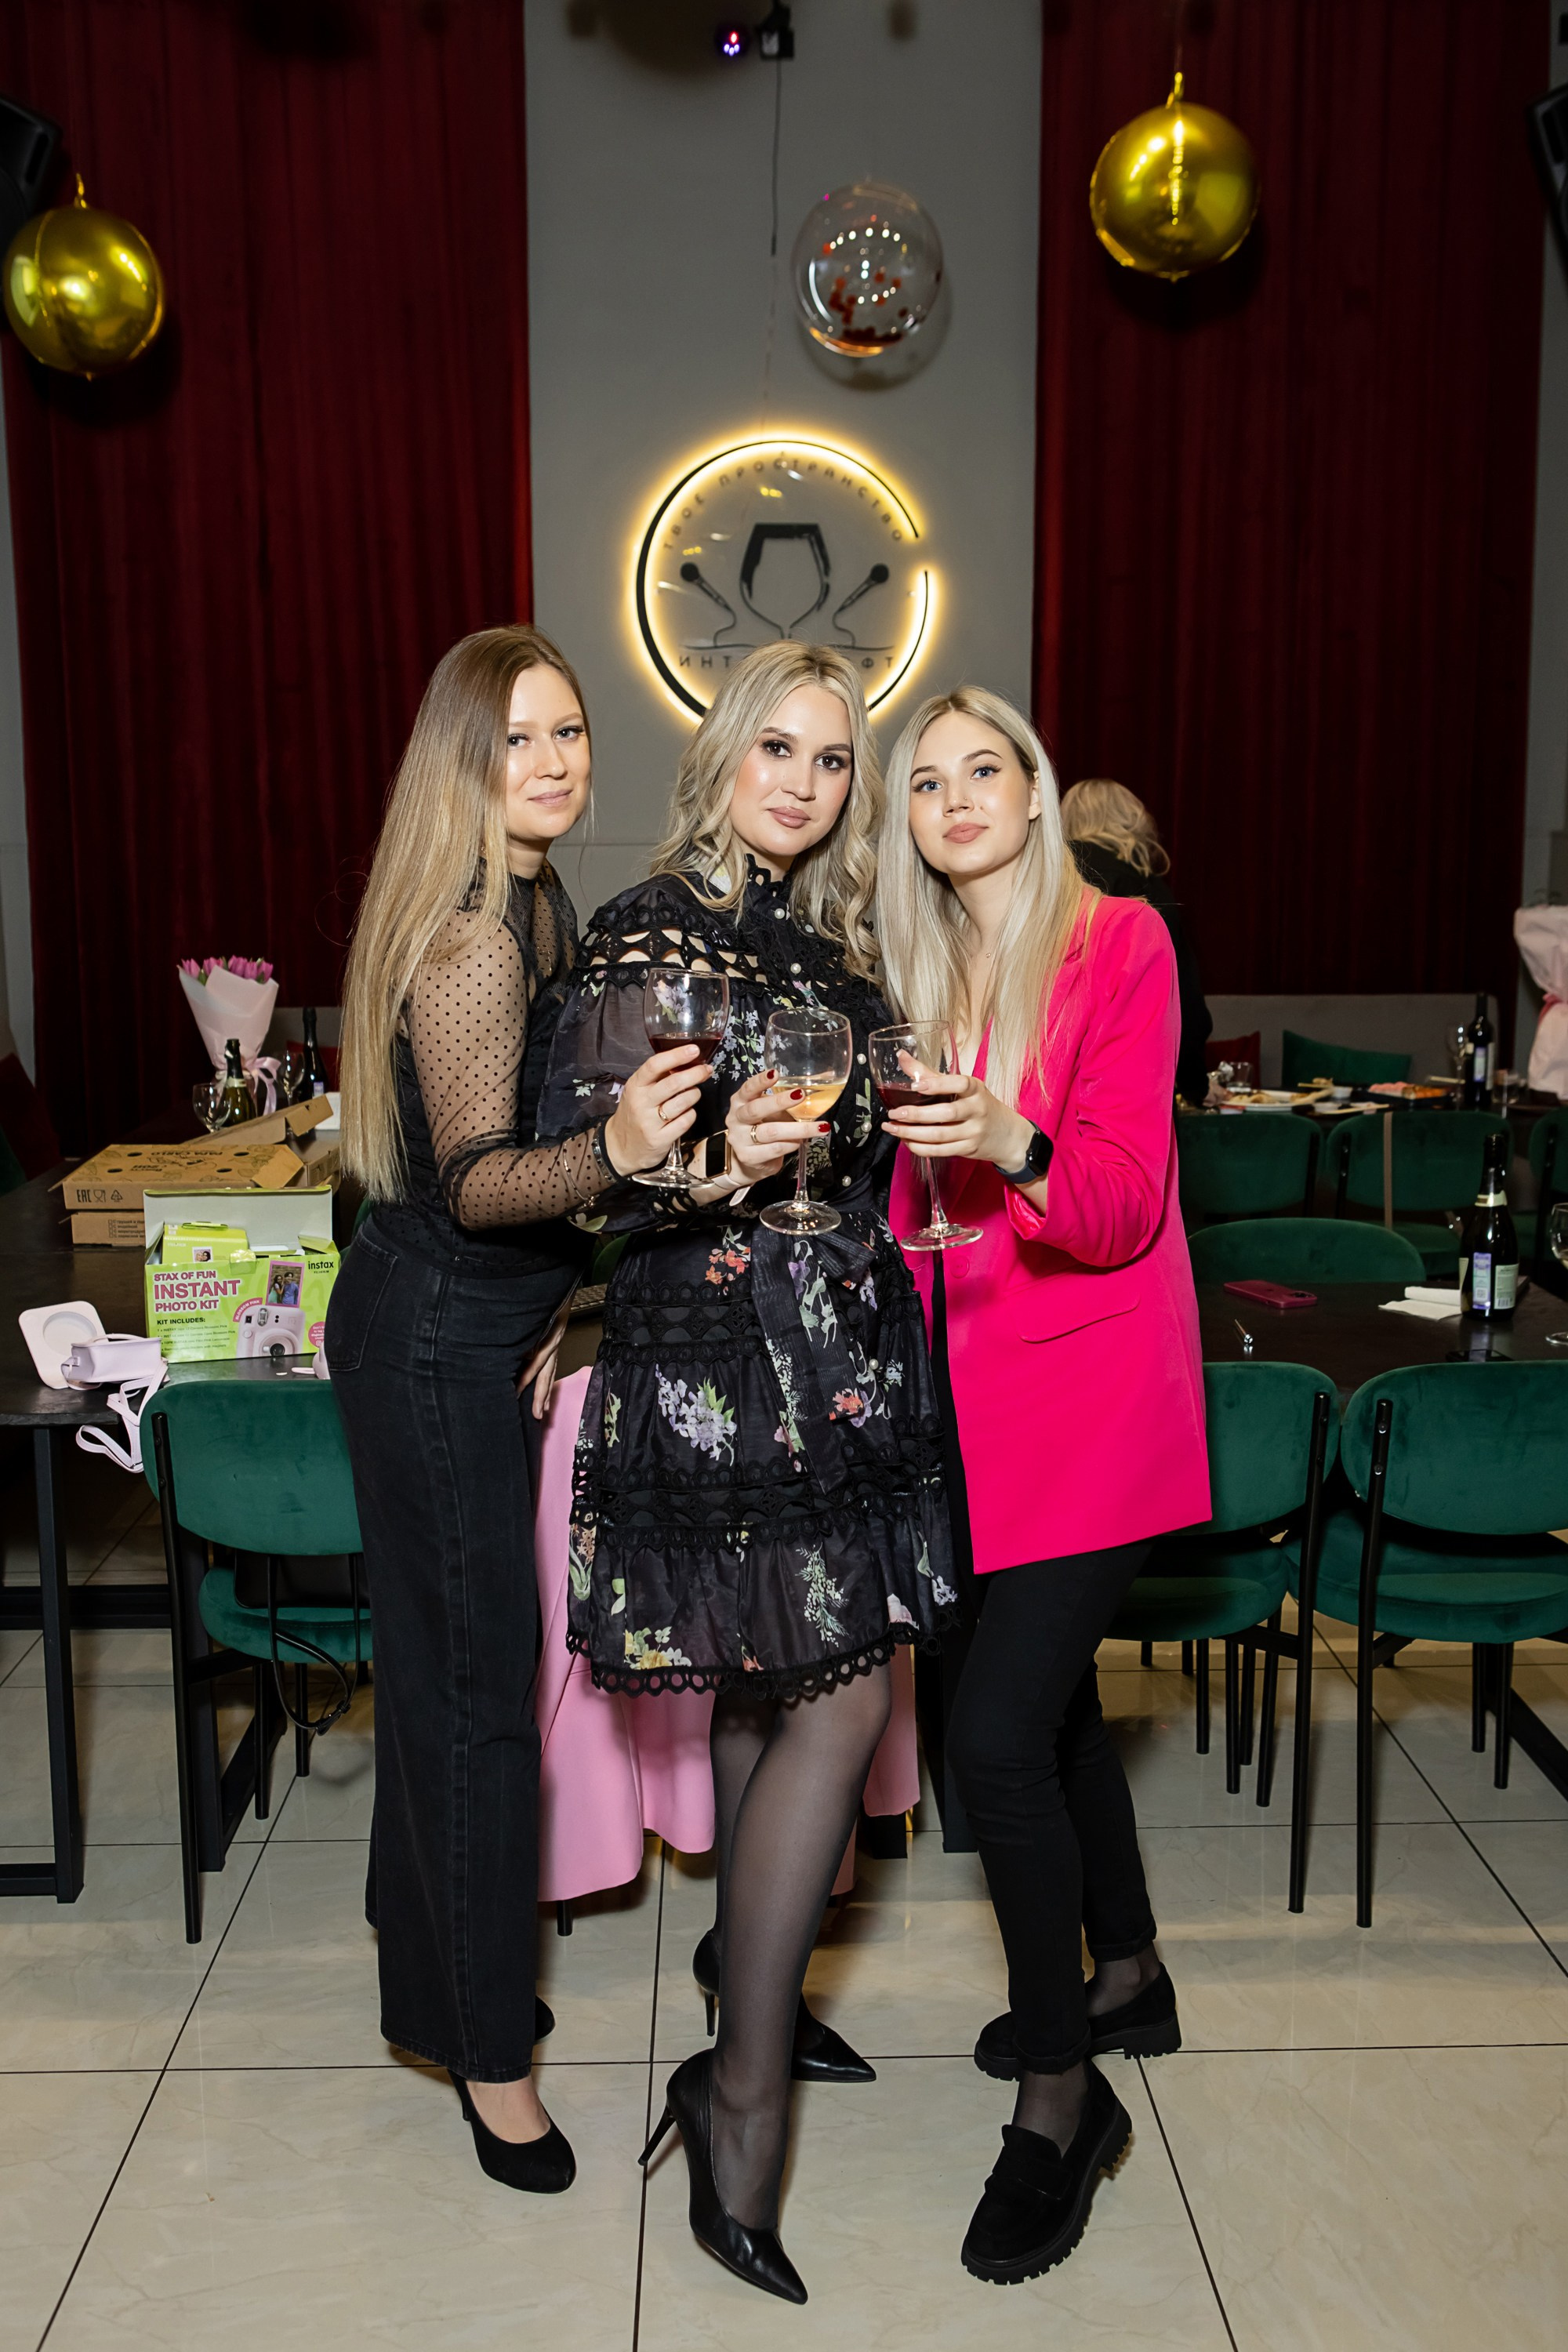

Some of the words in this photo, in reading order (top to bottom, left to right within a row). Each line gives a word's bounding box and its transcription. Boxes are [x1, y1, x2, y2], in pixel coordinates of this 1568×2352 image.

[663, 493, 705, 550] ТВОЕ
[307, 1261, 334, 1269] instax
[154, 1272, 179, 1282] STAX
[154, 1279, 241, 1300] INSTANT
[155, 1301, 197, 1312] PHOTO
[200, 1300, 219, 1309] KIT
[235, 1302, 249, 1320] BLOSSOM
